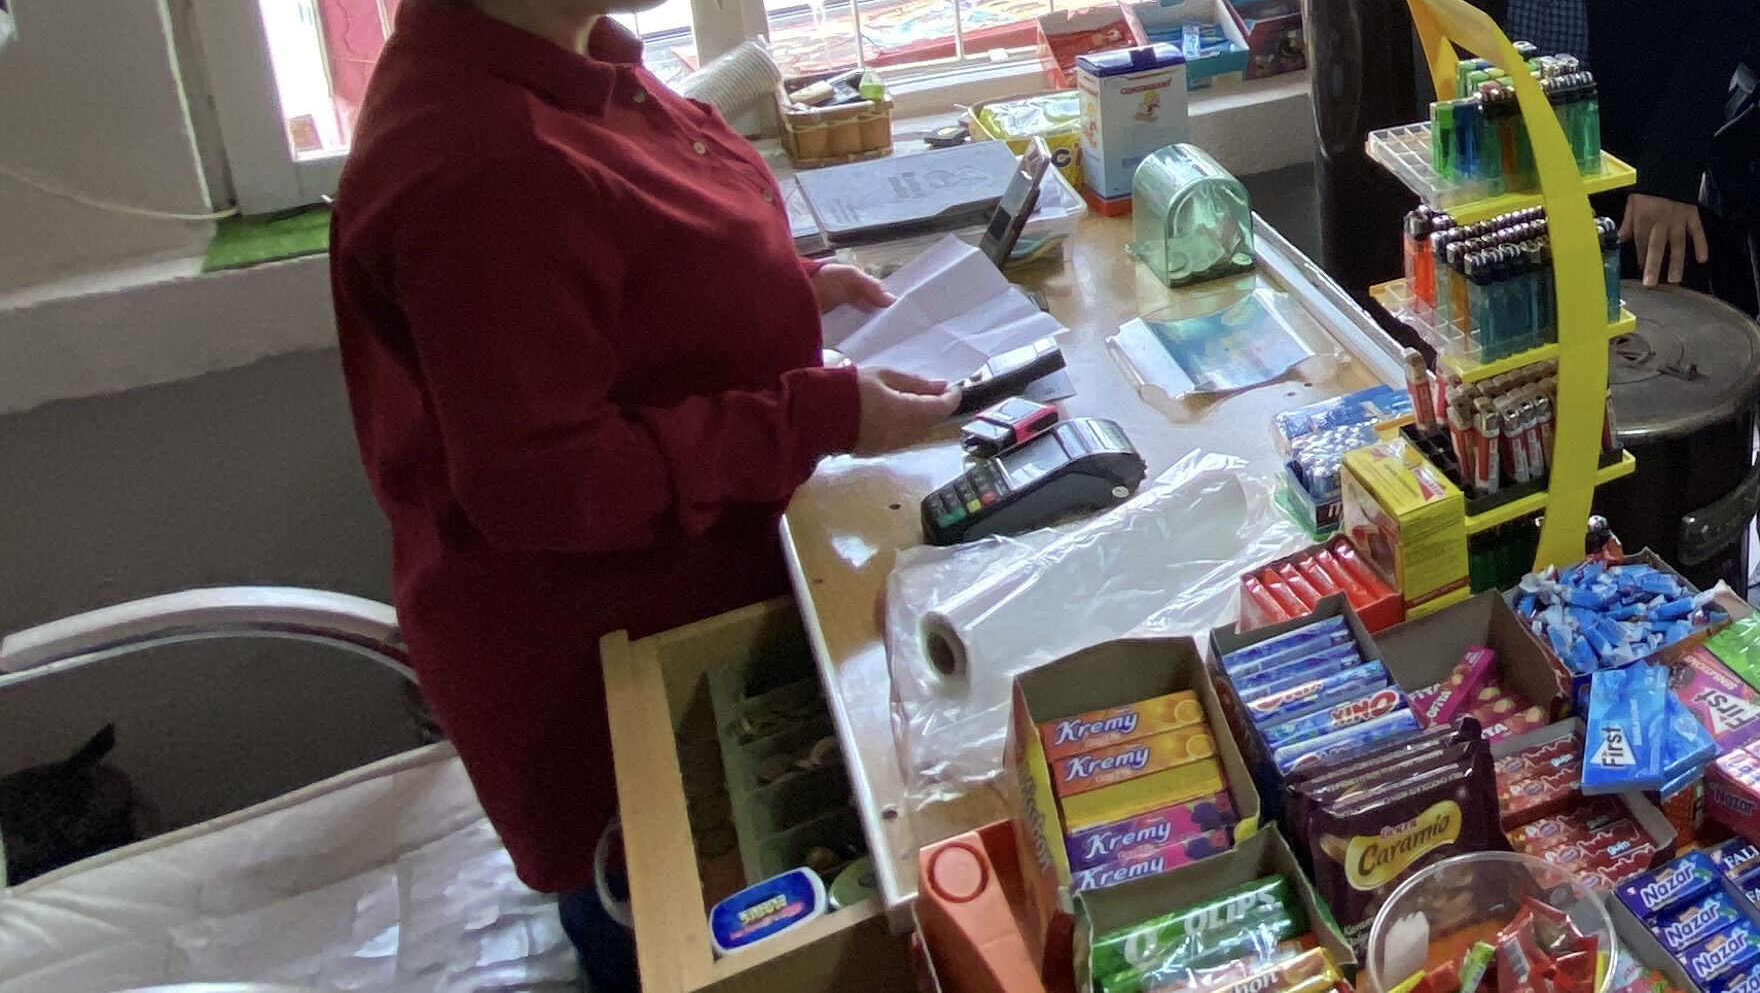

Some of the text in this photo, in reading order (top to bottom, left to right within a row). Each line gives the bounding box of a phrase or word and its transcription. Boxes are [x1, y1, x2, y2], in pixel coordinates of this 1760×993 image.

[1055, 706, 1139, 746] Kremy
[1692, 689, 1760, 730] First
[1066, 745, 1150, 783] Kremy
[1602, 725, 1625, 769] First
[1714, 785, 1756, 814] Nazar
[1085, 819, 1173, 861] Kremy
[1357, 813, 1451, 877] Caramio
[1722, 845, 1760, 873] FALI
[1078, 855, 1165, 891] Kremy
[1640, 858, 1698, 909] Nazar
[1665, 901, 1721, 950] Nazar
[1693, 930, 1748, 980] Nazar
